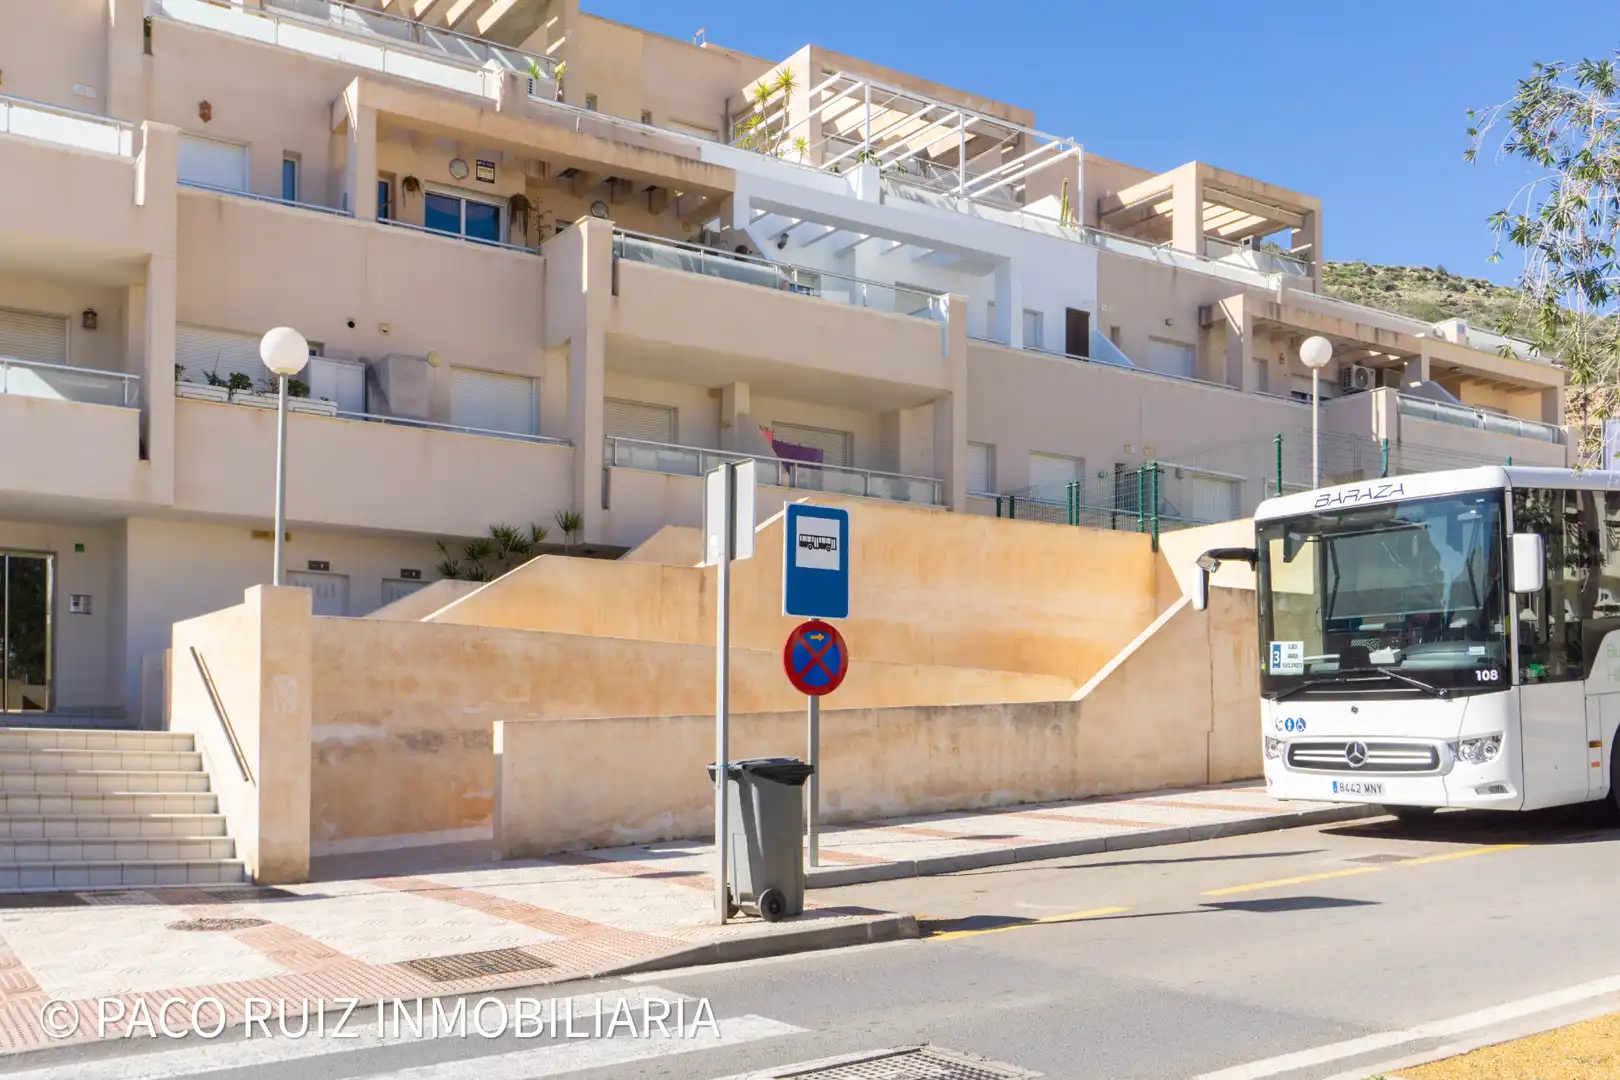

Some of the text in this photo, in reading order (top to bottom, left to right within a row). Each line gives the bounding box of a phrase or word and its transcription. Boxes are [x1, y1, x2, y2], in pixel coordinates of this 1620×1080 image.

[1314, 482, 1404, 508] BARAZA
[1273, 651, 1280, 664] 3
[1475, 669, 1499, 682] 108
[1339, 782, 1382, 794] 8442 MNY
